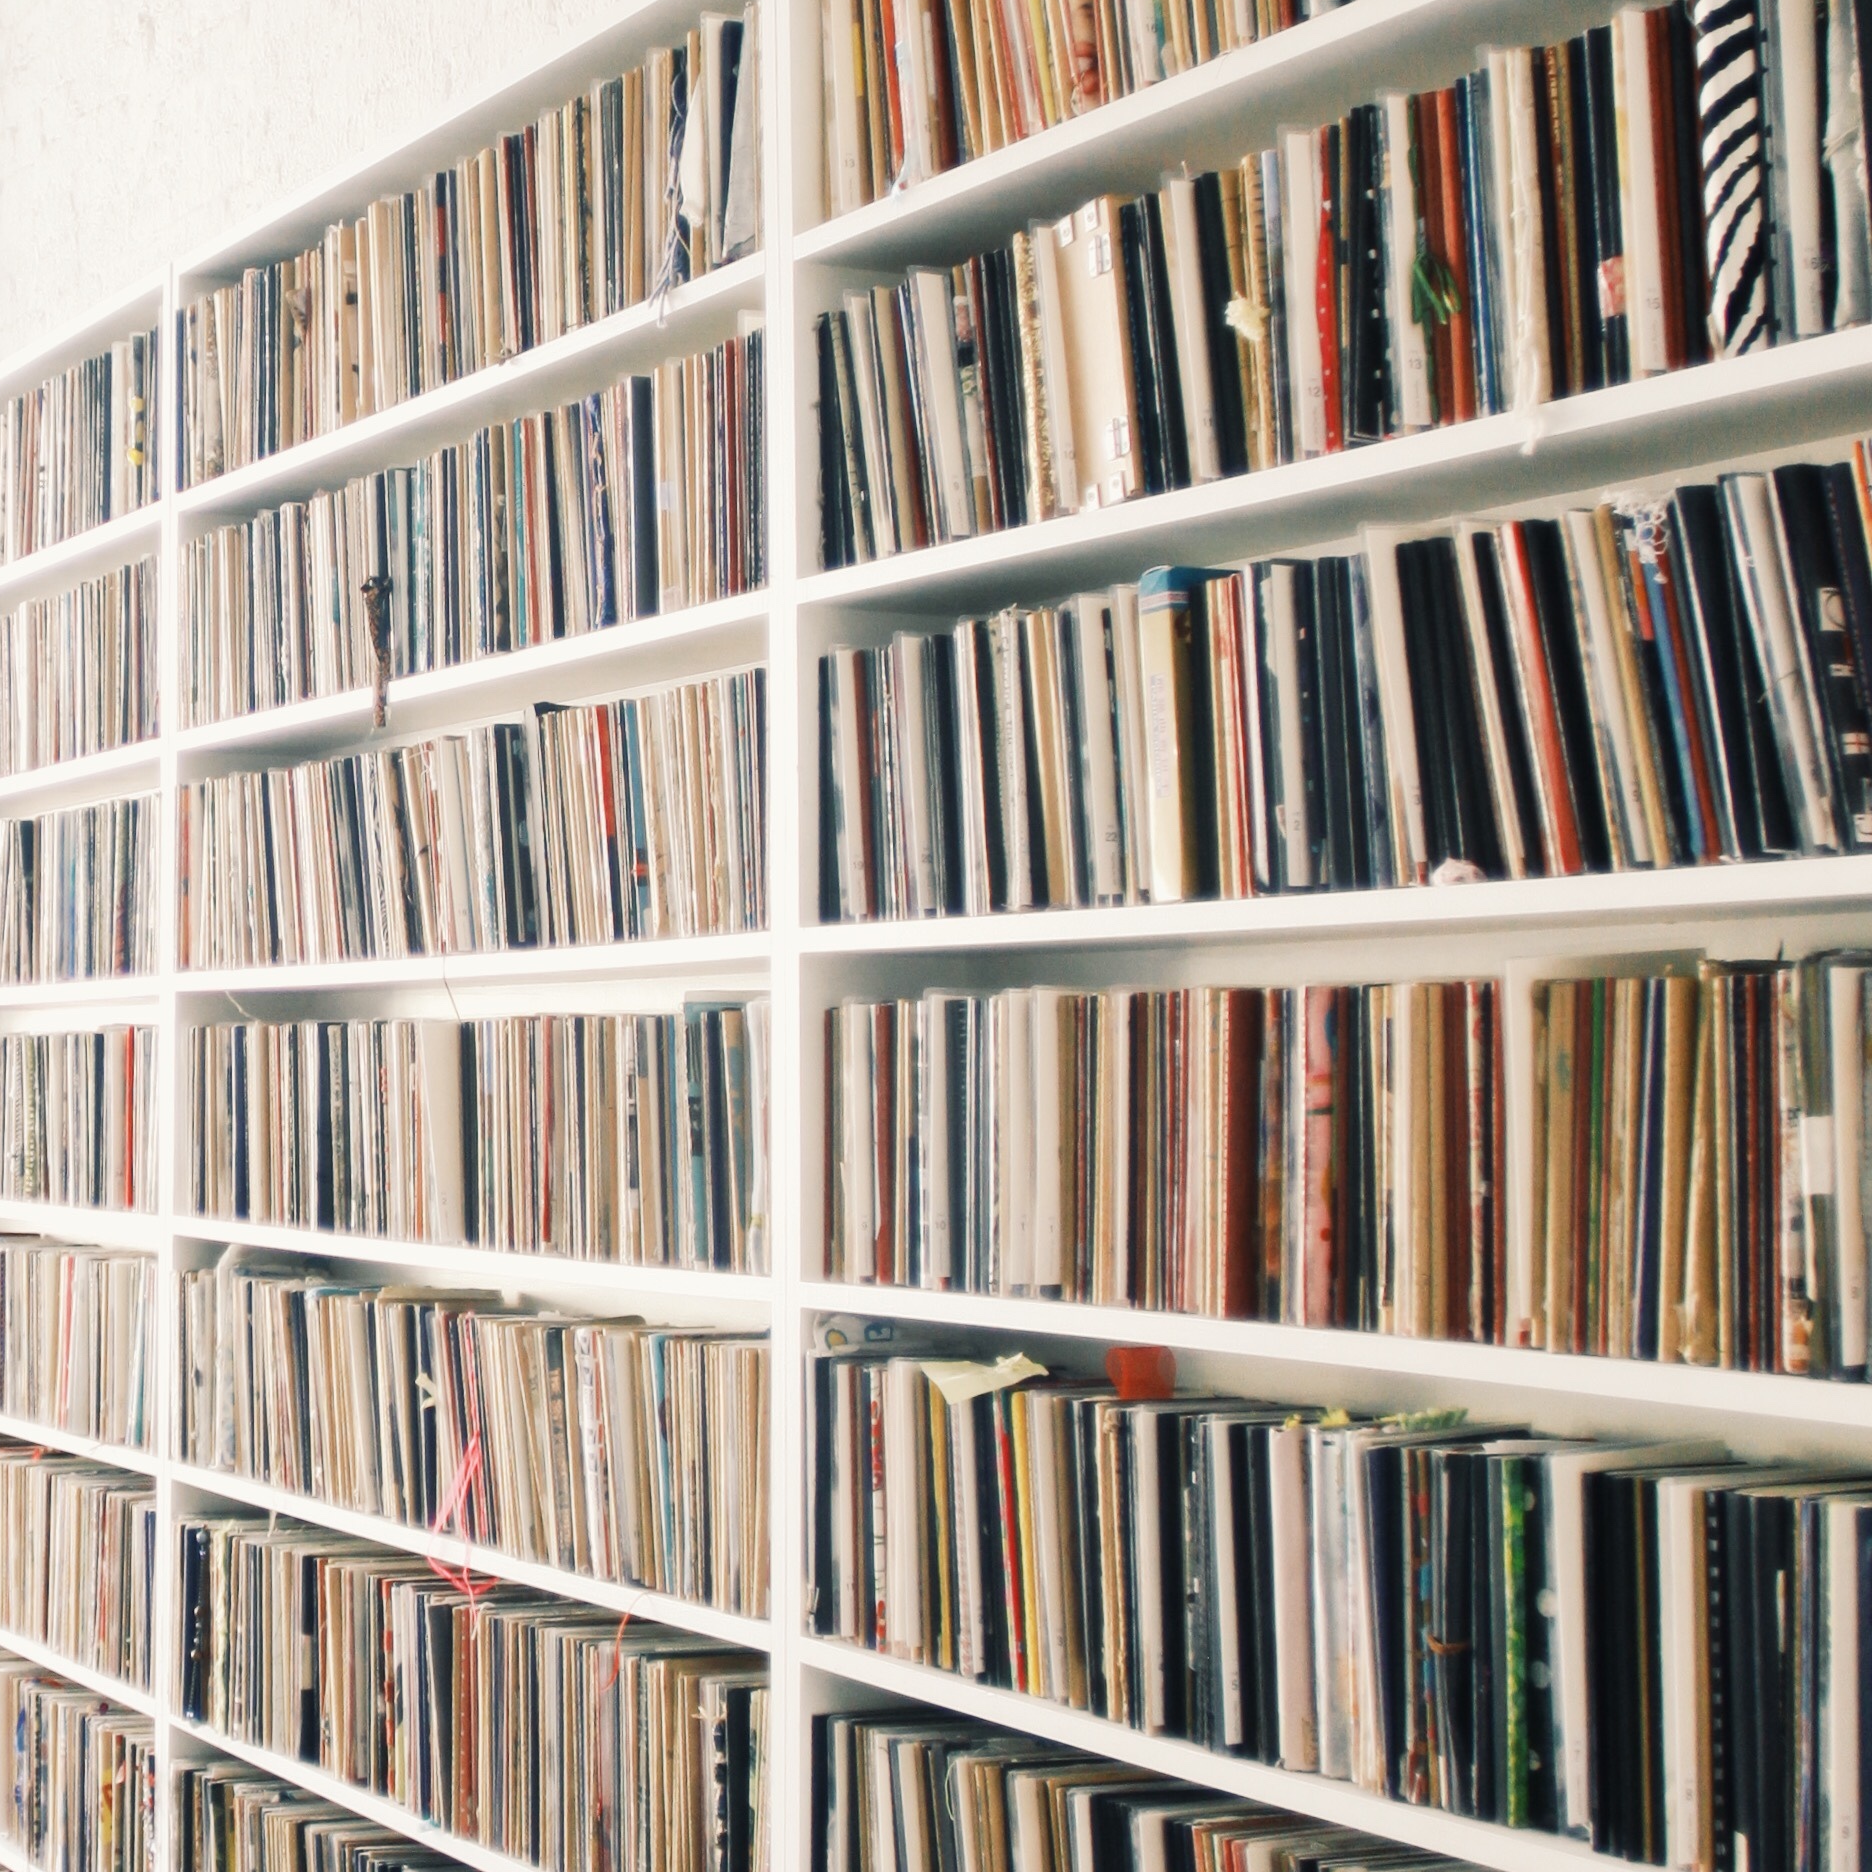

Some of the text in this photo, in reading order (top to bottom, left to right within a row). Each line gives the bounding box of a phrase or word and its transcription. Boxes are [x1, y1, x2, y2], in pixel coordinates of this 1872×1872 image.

[844, 158, 855, 168] 13
[1646, 297, 1661, 310] 15
[1408, 358, 1423, 370] 13
[1308, 386, 1321, 398] 12
[935, 1220, 946, 1230] 10
